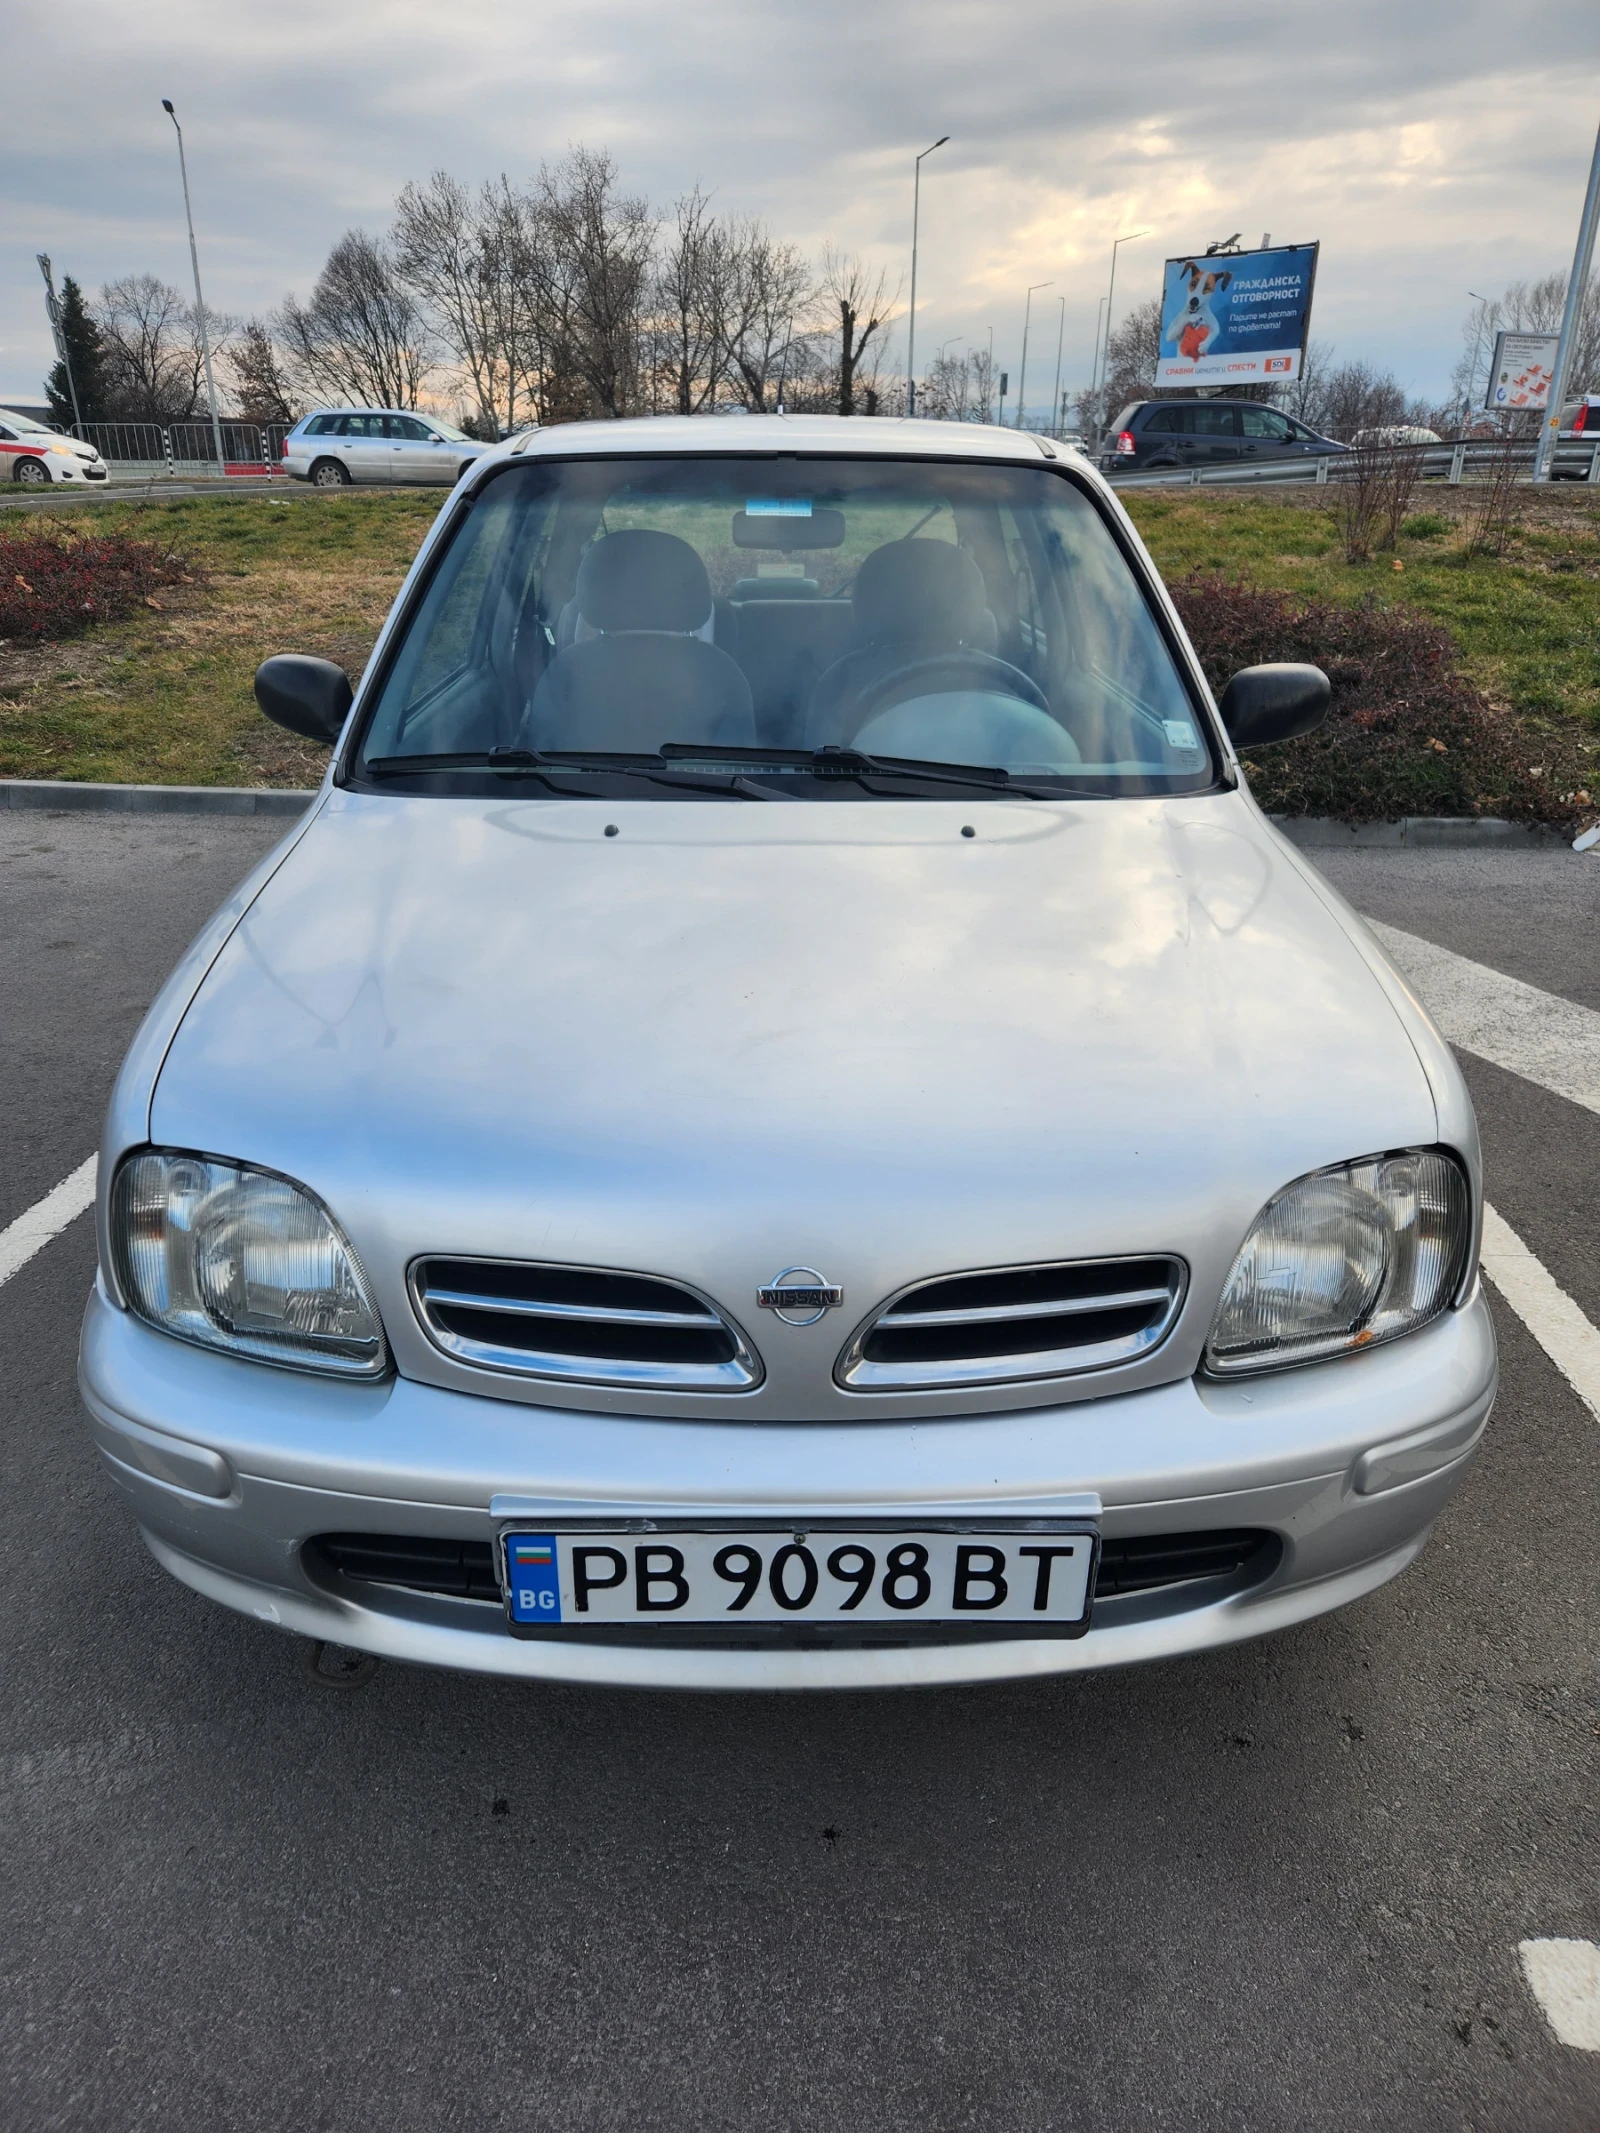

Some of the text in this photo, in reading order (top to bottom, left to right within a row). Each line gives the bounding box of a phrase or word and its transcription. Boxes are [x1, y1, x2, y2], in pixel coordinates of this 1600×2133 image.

[1234, 275, 1301, 290] ГРАЖДАНСКА
[1232, 288, 1300, 303] ОТГОВОРНОСТ
[1230, 313, 1257, 322] Парите
[1165, 367, 1194, 375] СРАВНИ
[1195, 366, 1220, 374] цените
[1227, 363, 1257, 372] СПЕСТИ
[766, 1290, 834, 1305] NISSAN
[572, 1543, 1074, 1612] PB 9098 BT
[519, 1589, 556, 1610] BG
